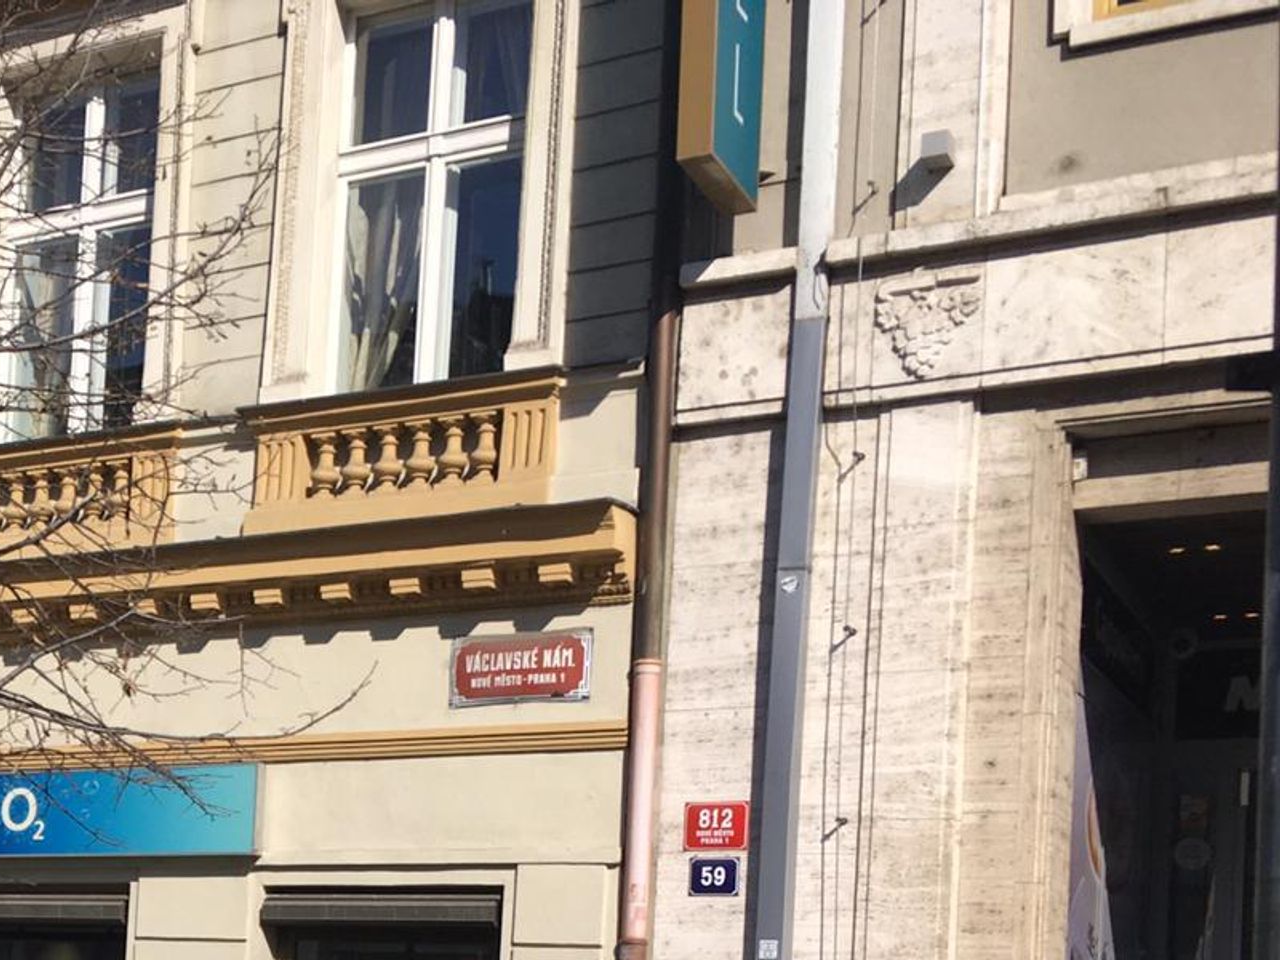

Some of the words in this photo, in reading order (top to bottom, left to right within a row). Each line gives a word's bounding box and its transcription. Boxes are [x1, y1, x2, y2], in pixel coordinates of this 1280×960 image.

[465, 646, 539, 674] VÁCLAVSKÉ
[542, 642, 576, 668] NÁM.
[471, 673, 492, 689] NOVÉ
[559, 672, 566, 684] 1
[698, 807, 733, 829] 812
[700, 865, 726, 887] 59
